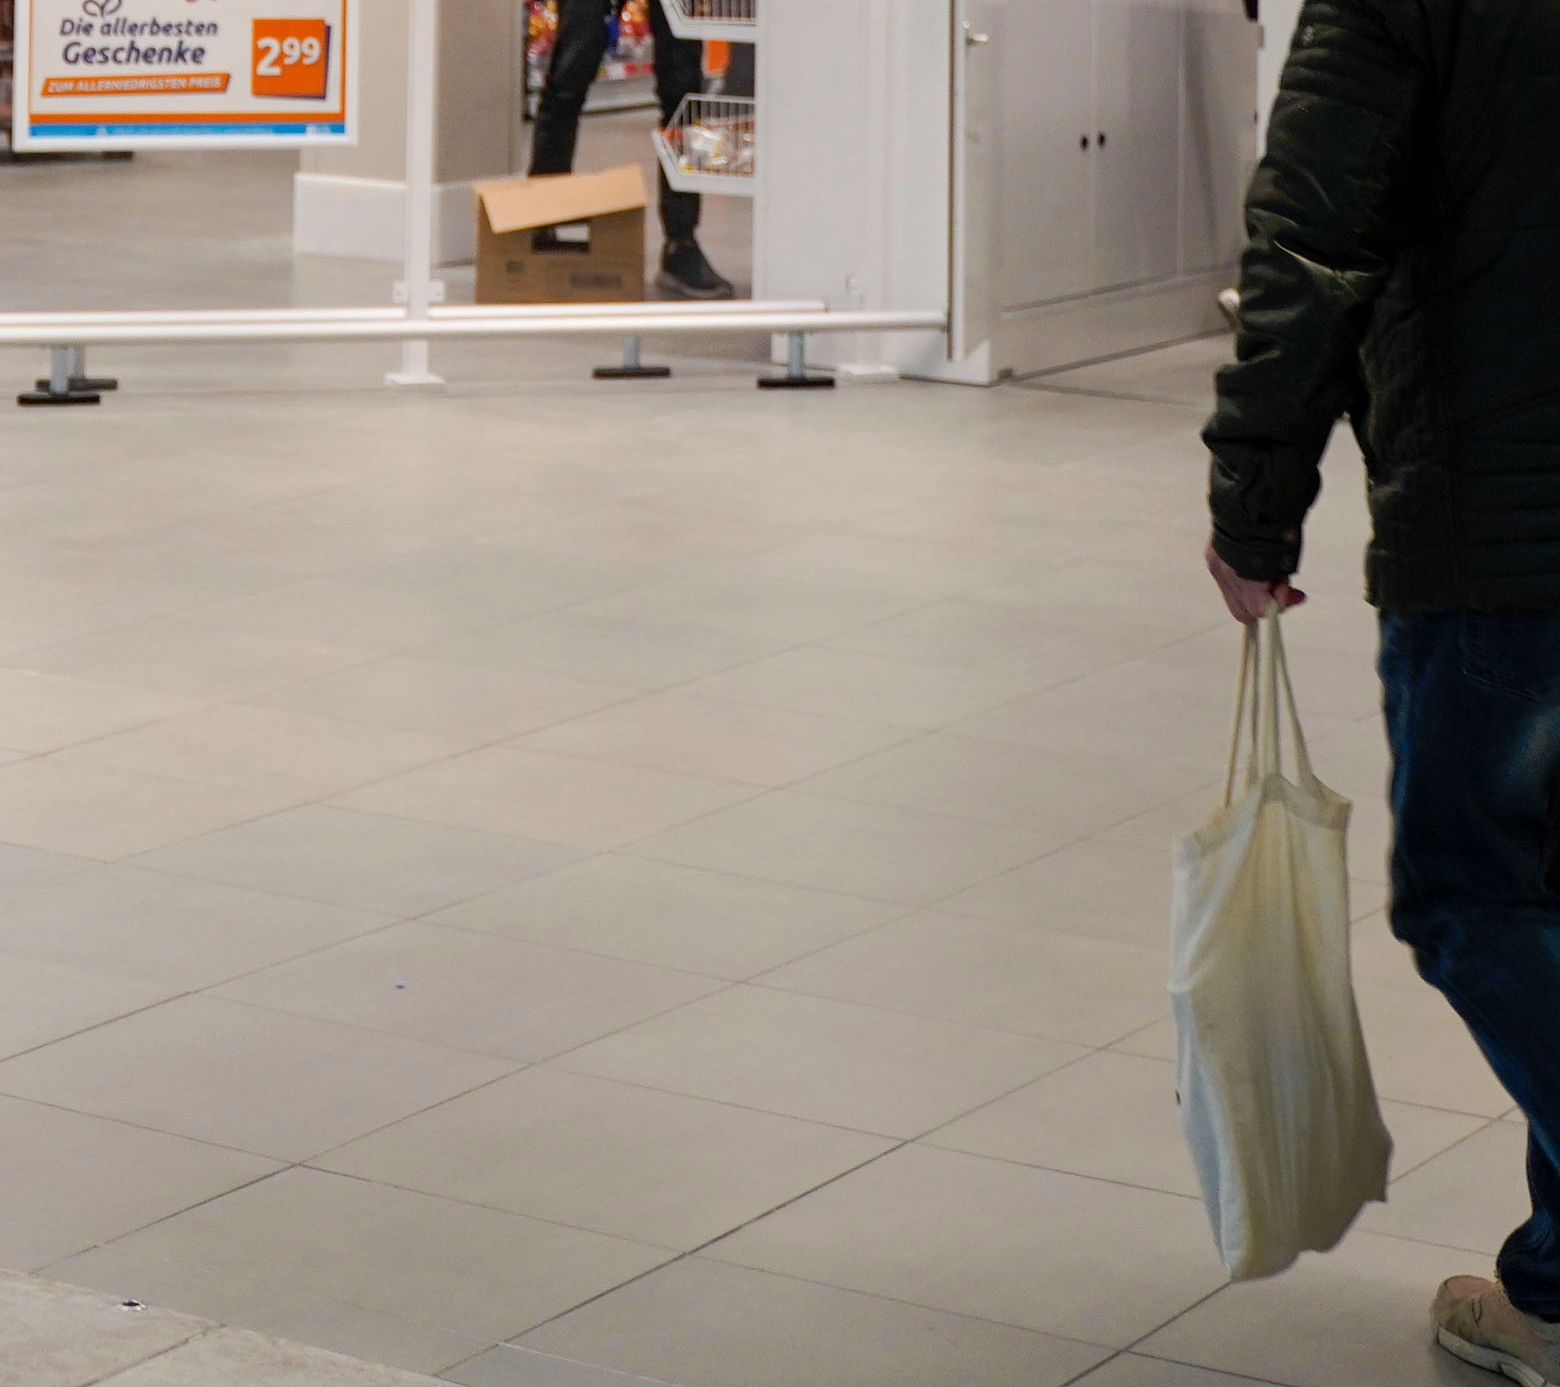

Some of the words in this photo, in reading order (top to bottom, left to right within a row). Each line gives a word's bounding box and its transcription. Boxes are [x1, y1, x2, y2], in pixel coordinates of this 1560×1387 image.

[60, 18, 94, 37] Die
[99, 18, 219, 38] allerbesten
[62, 40, 206, 65] Geschenke
